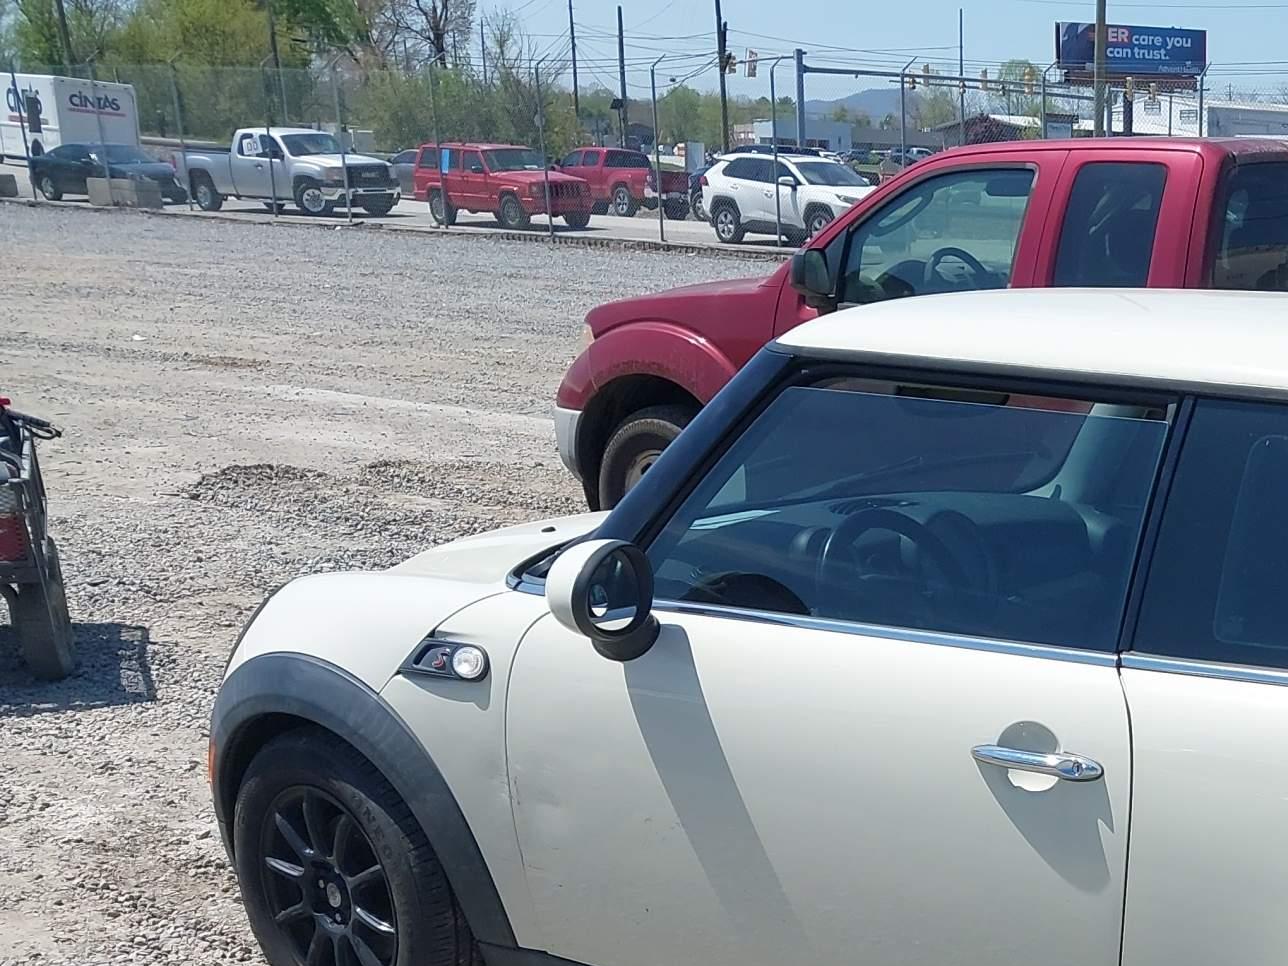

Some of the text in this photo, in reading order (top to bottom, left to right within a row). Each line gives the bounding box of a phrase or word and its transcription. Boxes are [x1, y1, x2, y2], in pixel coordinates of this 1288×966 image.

[1107, 27, 1192, 50] ER care you
[1106, 47, 1170, 60] can trust.
[69, 90, 121, 111] CINTAS
